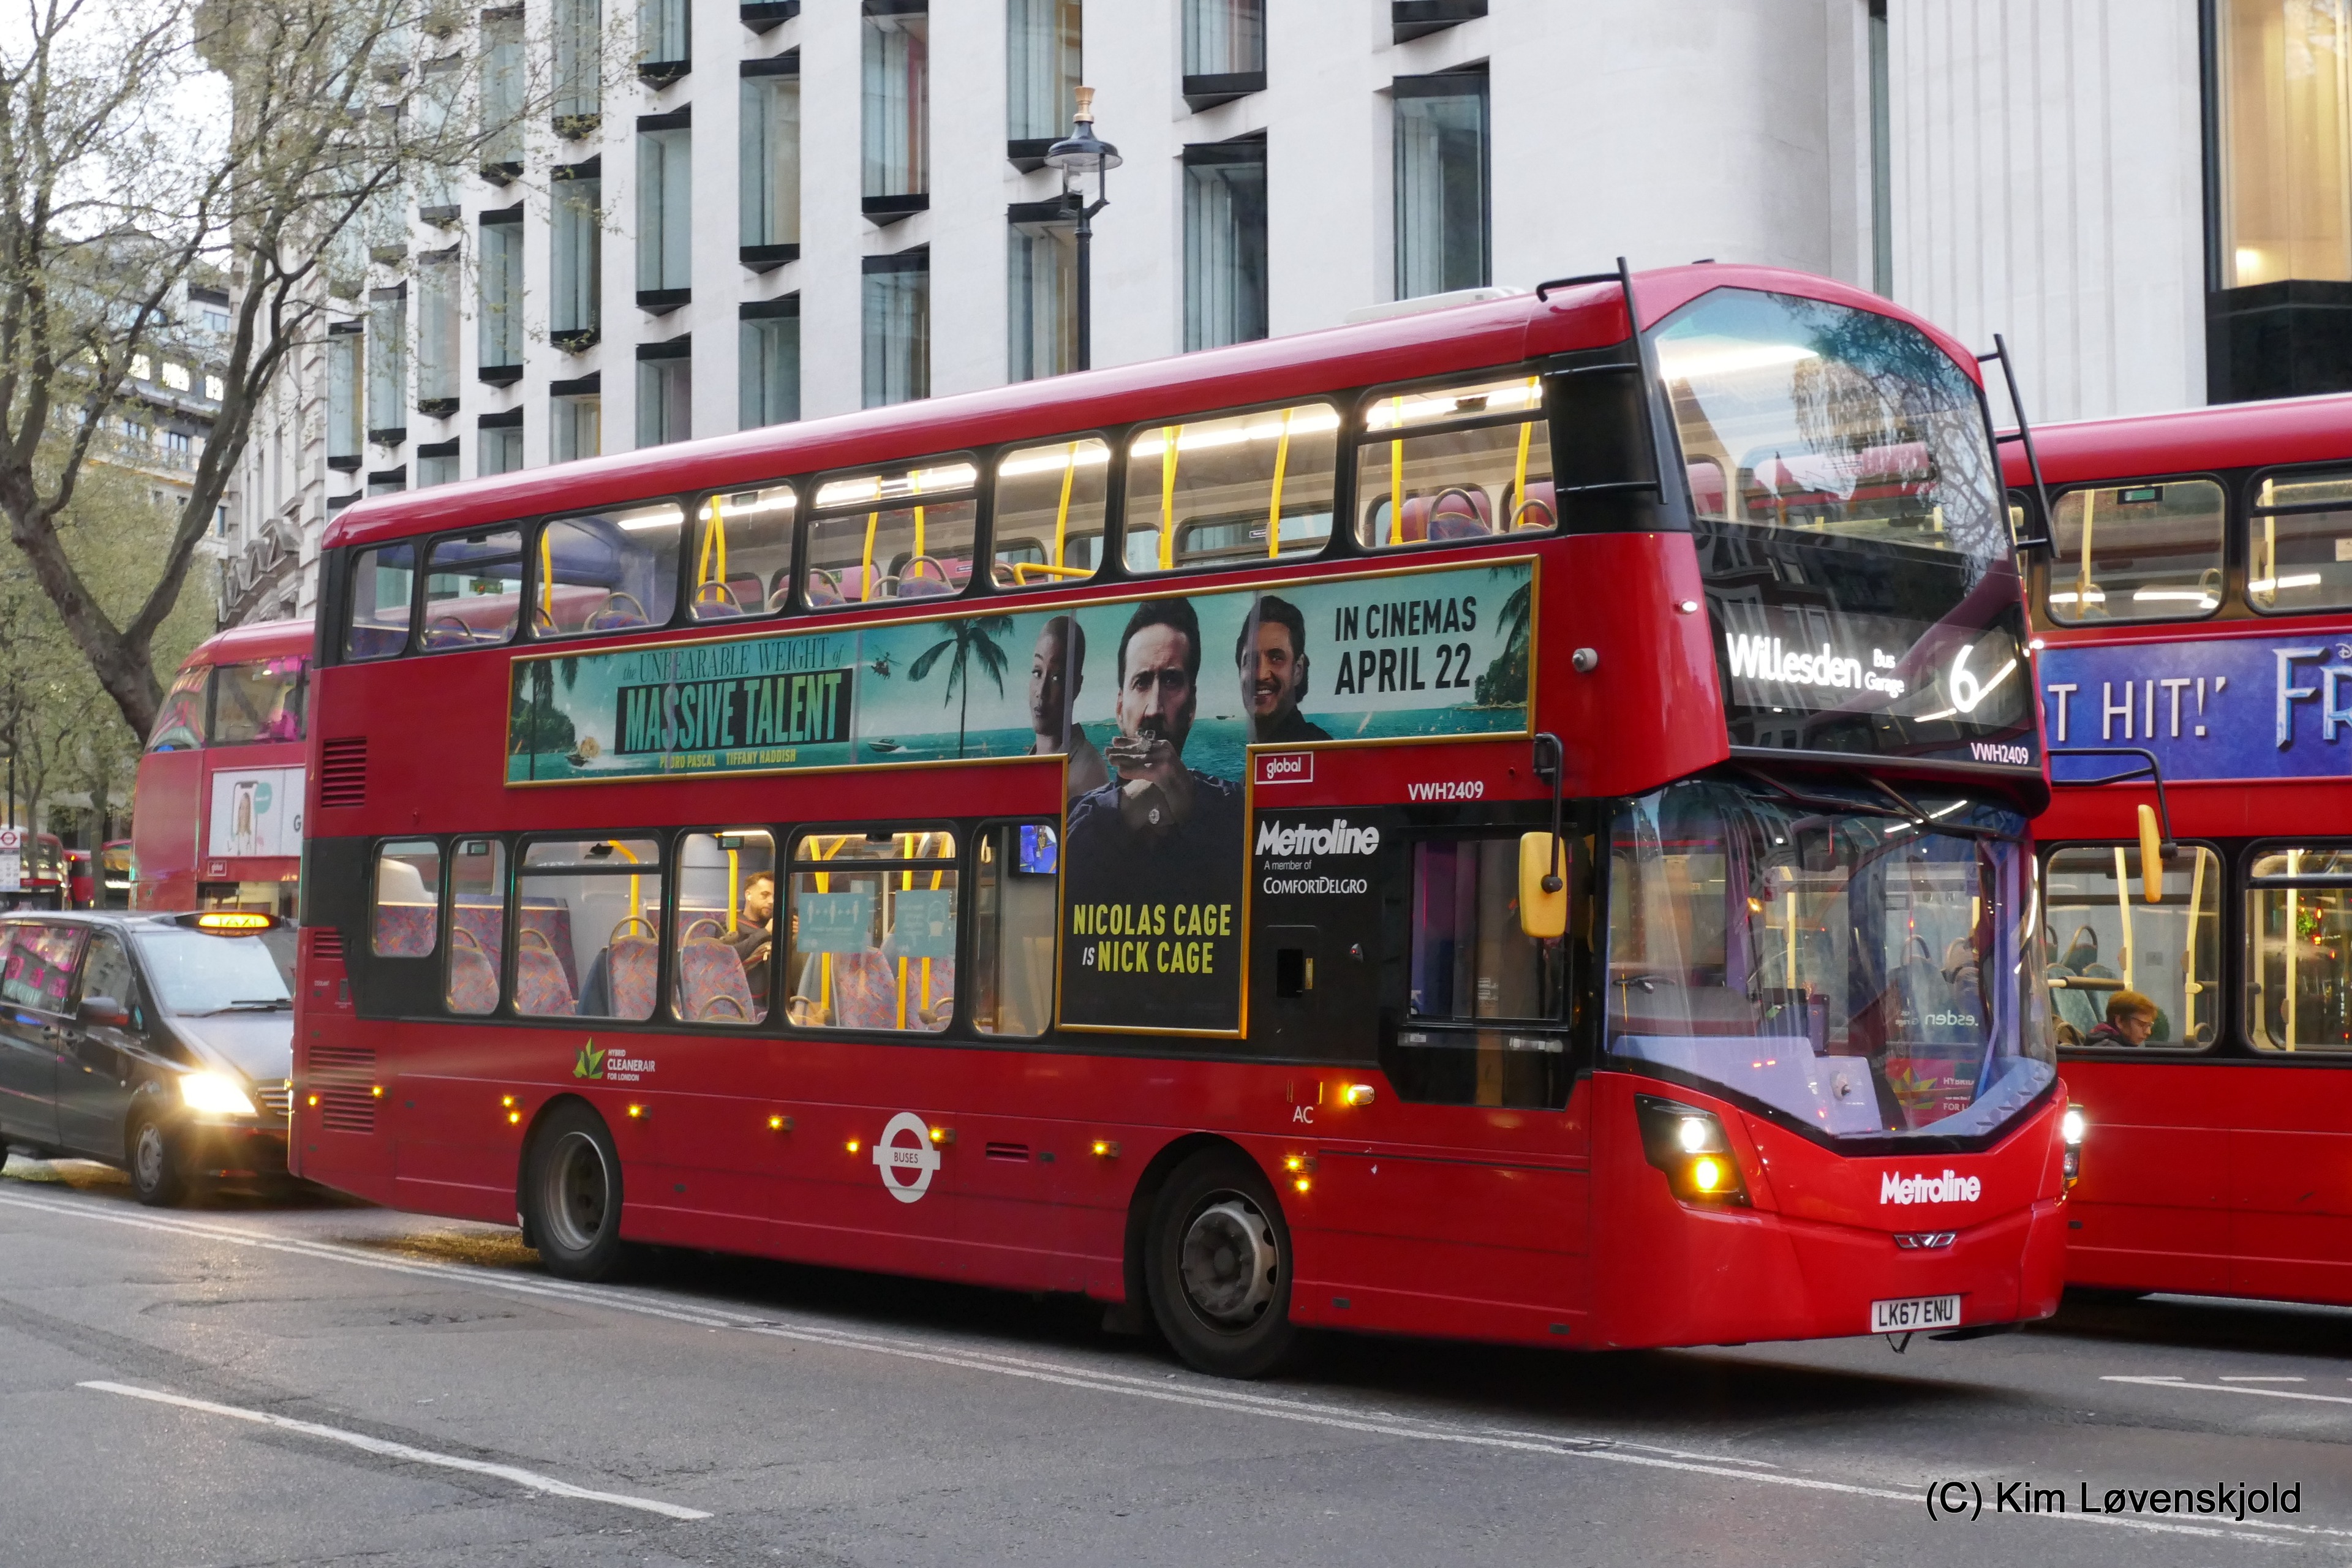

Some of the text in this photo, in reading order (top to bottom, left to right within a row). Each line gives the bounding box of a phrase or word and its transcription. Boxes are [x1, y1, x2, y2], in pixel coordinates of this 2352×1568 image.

[1335, 595, 1476, 642] IN CINEMAS
[622, 637, 844, 682] the UNBEARABLE WEIGHT of
[1334, 643, 1471, 695] APRIL 22
[1726, 633, 1861, 688] Willesden
[1874, 649, 1896, 669] Bus
[1865, 672, 1905, 698] Garage
[1950, 645, 1978, 712] 6
[626, 673, 842, 752] MASSIVE TALENT
[687, 754, 716, 769] PASCAL
[726, 750, 758, 766] TIFFANY
[760, 748, 797, 764] HADDISH
[1266, 756, 1302, 779] global
[1970, 743, 2029, 765] VWH2409
[1408, 780, 1484, 801] VWH2409
[1255, 818, 1379, 856] Metroline
[1264, 859, 1312, 870] A member of
[1073, 904, 1231, 936] NICOLAS CAGE
[1082, 941, 1213, 974] IS NICK CAGE
[618, 1072, 639, 1082] LONDON
[1292, 1106, 1314, 1124] AC
[894, 1152, 919, 1164] BUSES
[1880, 1169, 1981, 1205] Metroline
[1879, 1298, 1953, 1327] LK67 ENU
